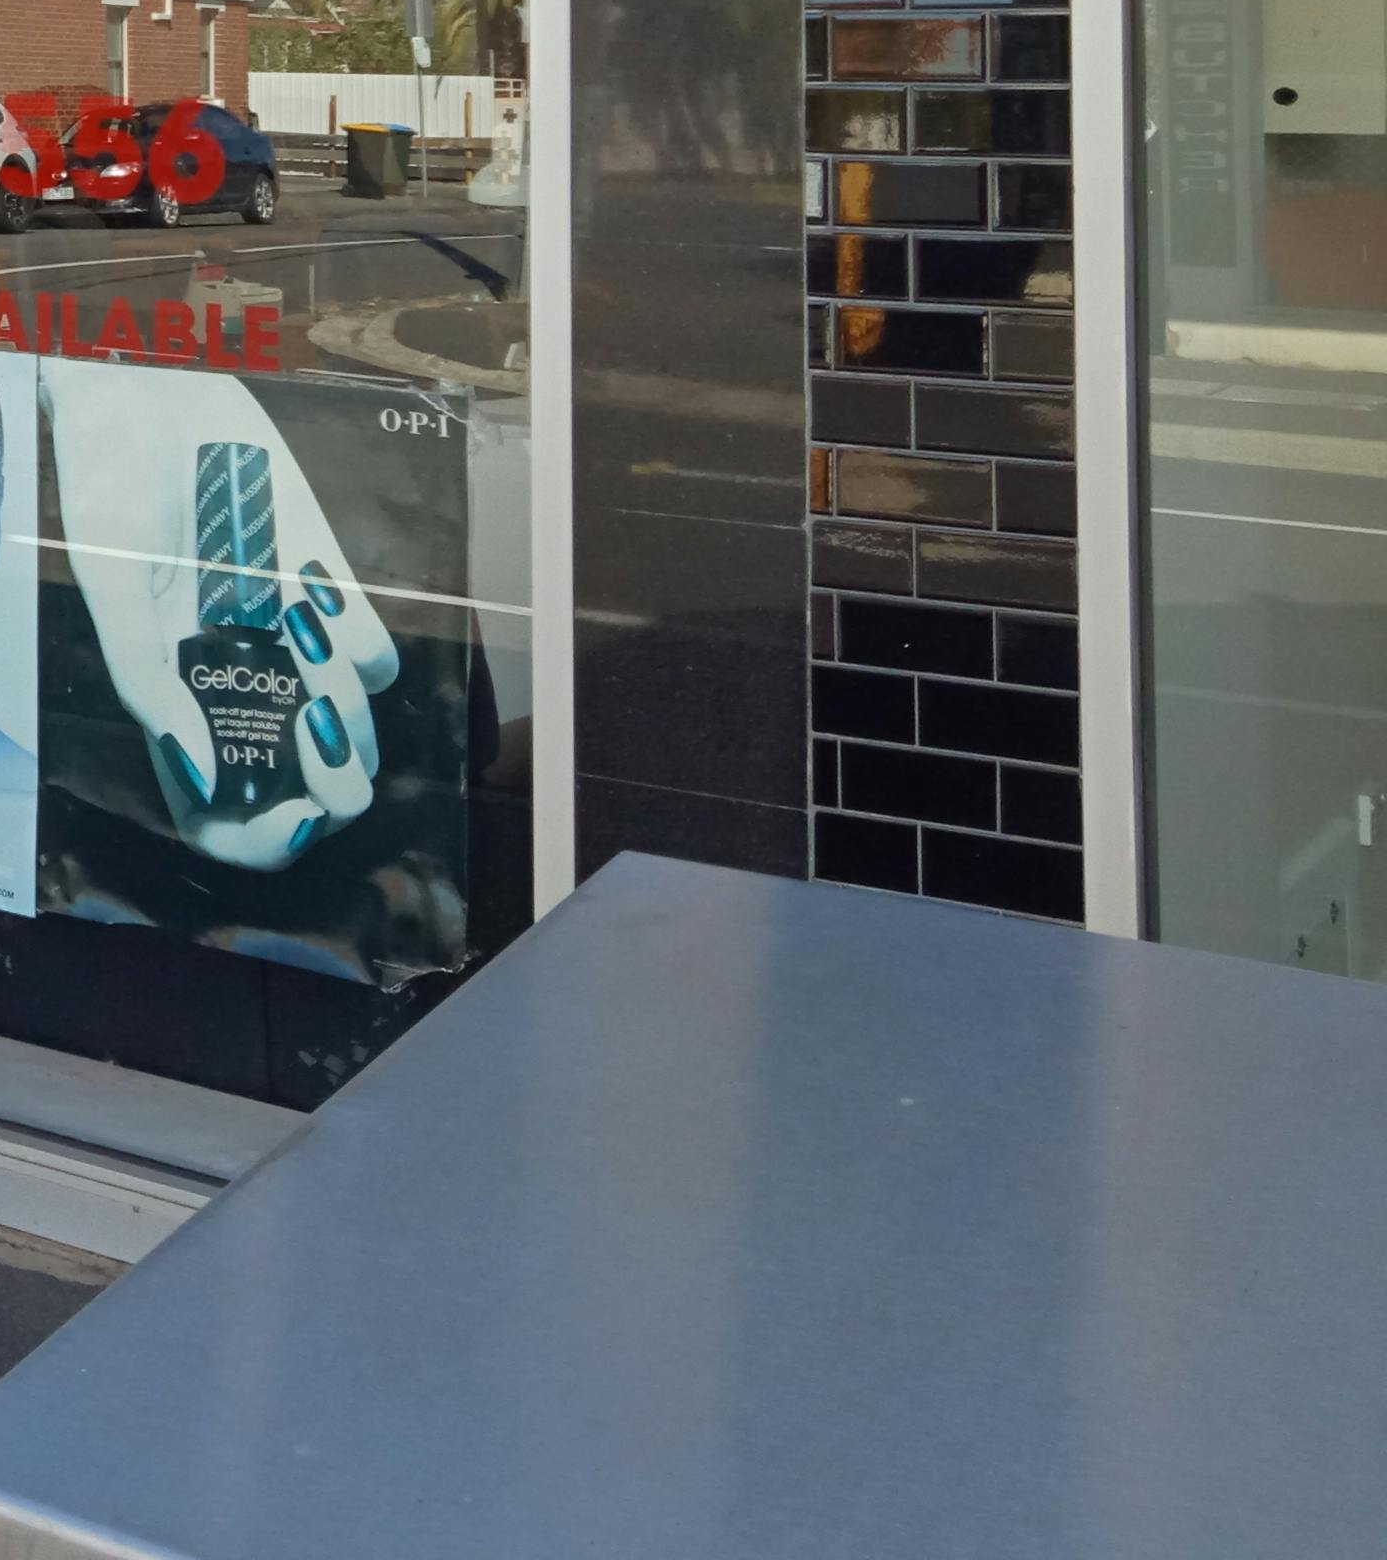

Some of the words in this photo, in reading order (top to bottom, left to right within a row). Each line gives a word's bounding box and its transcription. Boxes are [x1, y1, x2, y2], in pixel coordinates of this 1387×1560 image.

[191, 665, 300, 697] GelColor
[240, 708, 254, 718] gel
[255, 709, 286, 721] lacquer
[213, 718, 226, 728] gel
[248, 730, 261, 741] gel
